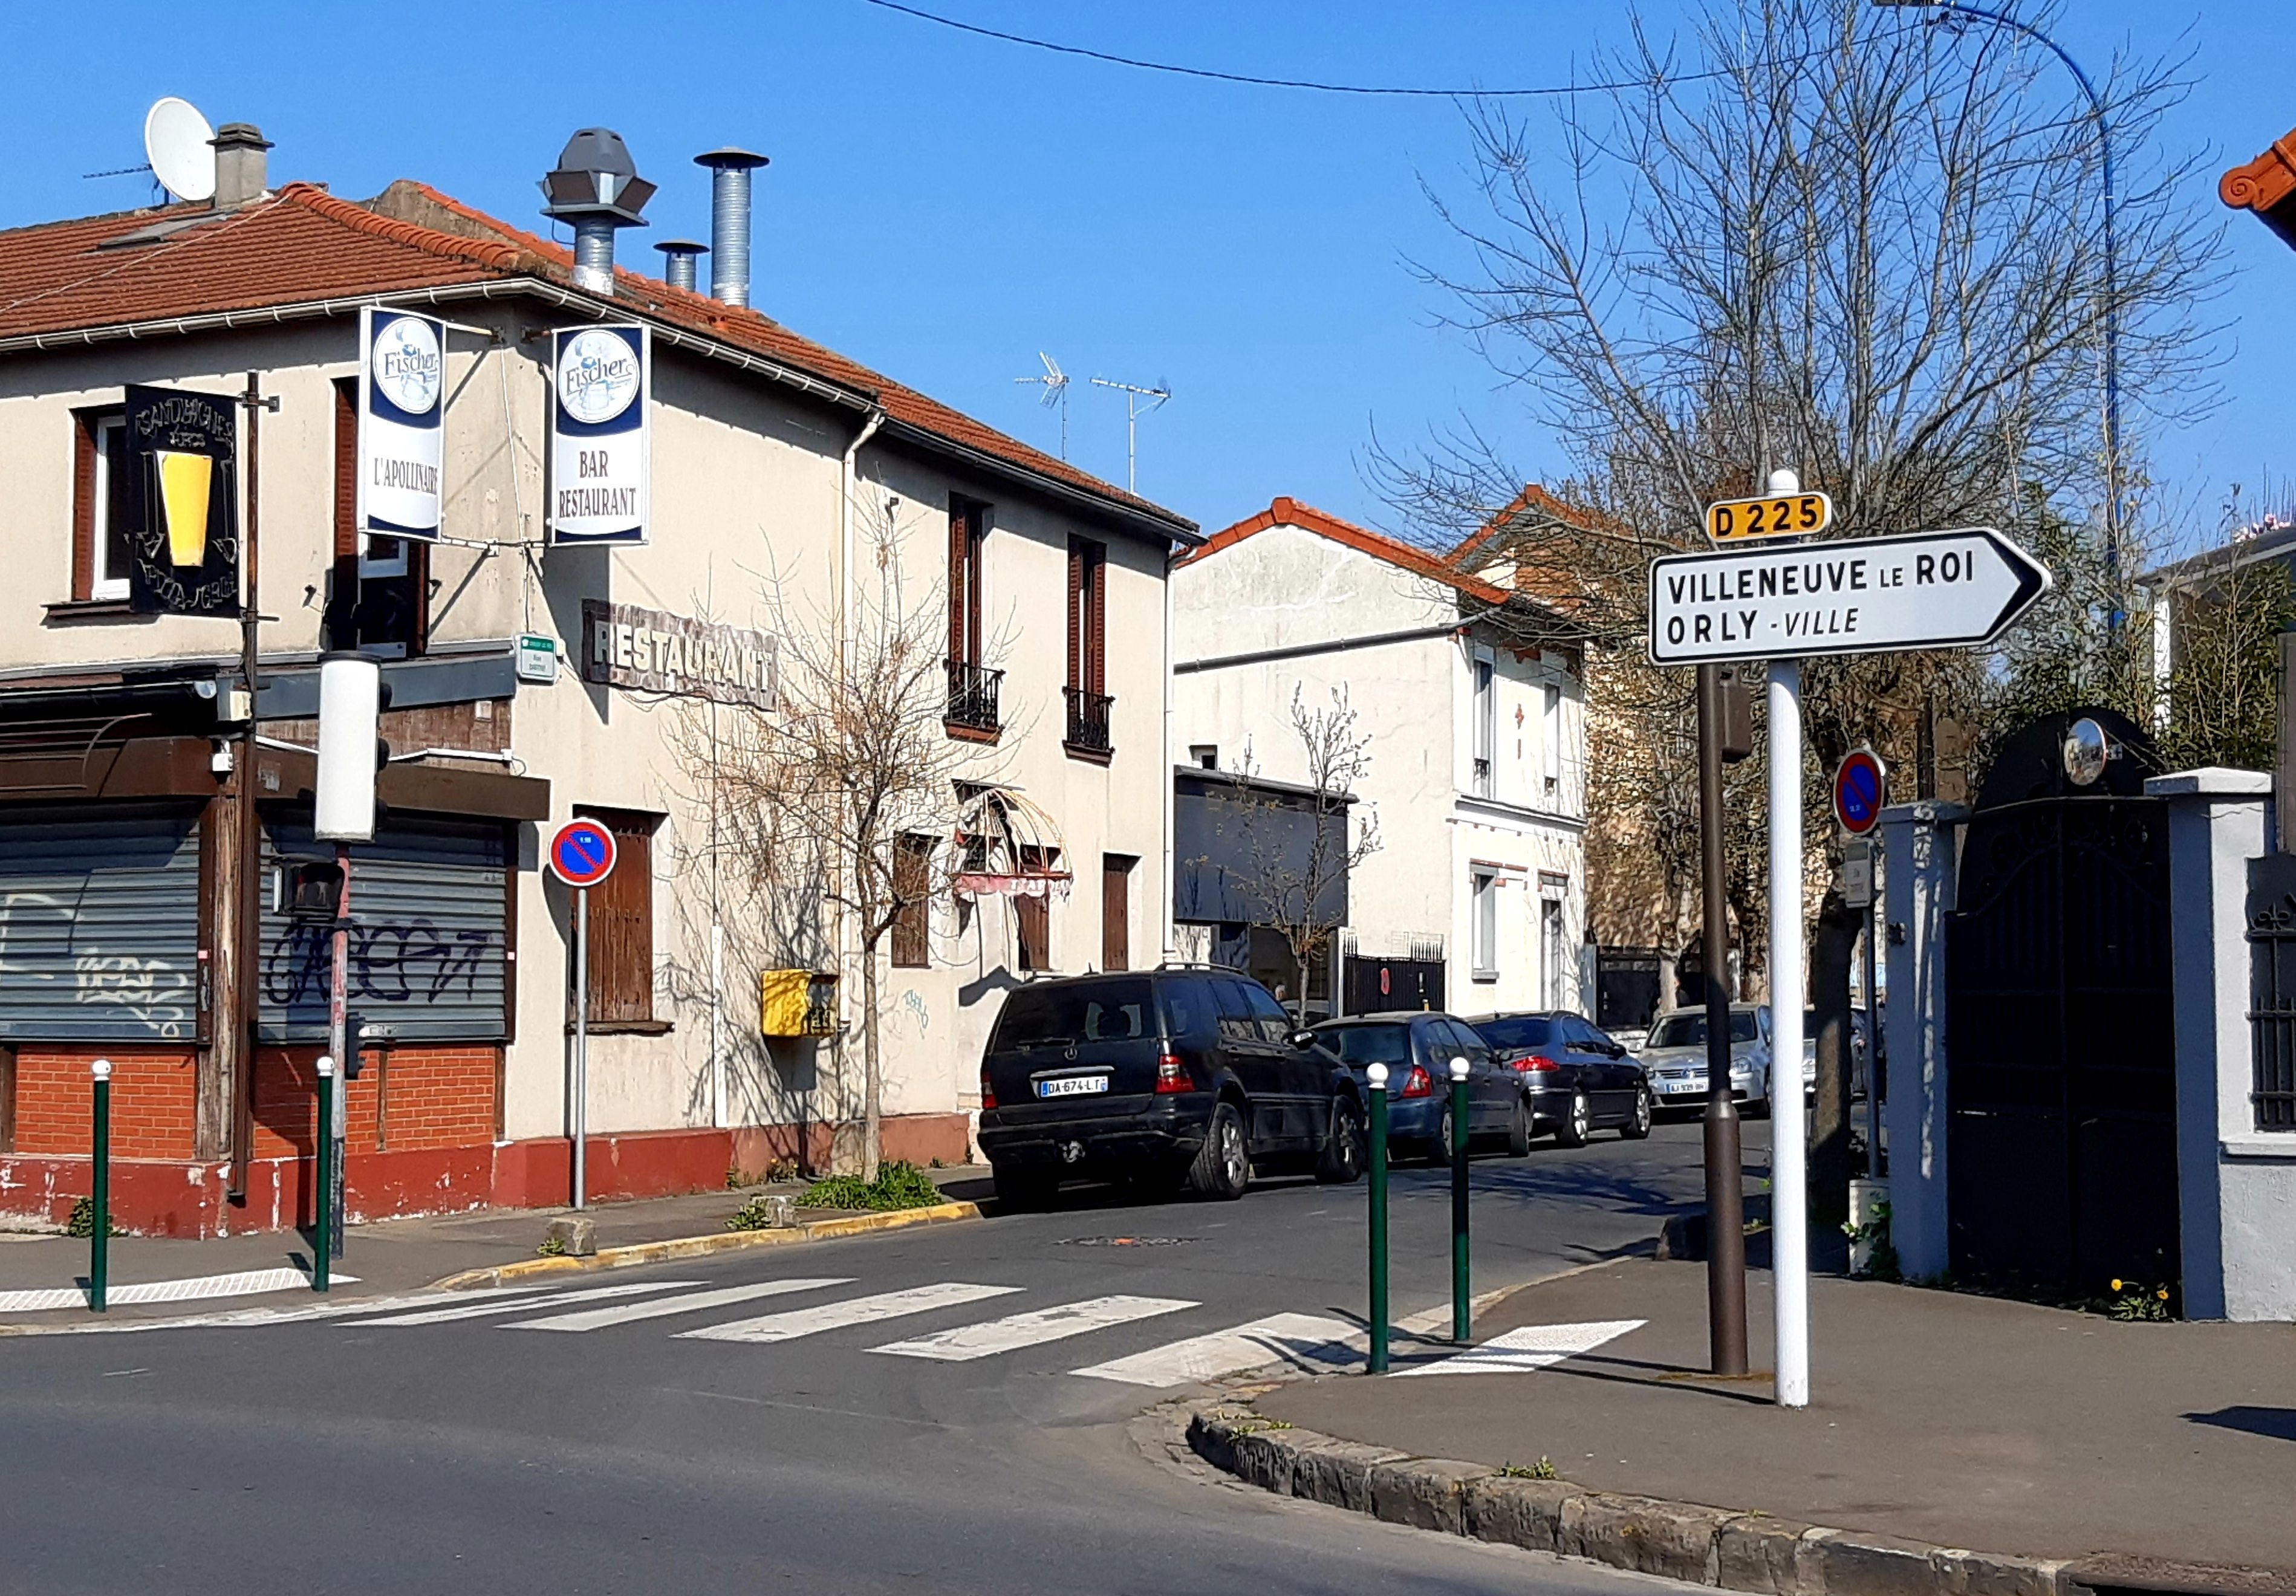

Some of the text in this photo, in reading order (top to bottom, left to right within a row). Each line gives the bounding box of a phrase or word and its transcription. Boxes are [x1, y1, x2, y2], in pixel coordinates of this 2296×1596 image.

[384, 348, 438, 378] Fischer
[565, 357, 633, 396] Fischer
[579, 450, 608, 478] BAR
[559, 487, 637, 519] RESTAURANT
[1715, 498, 1816, 536] D 225
[1668, 550, 1973, 605] VILLENEUVE LE ROI
[1667, 610, 1758, 645] ORLY
[593, 619, 773, 692] RESTAURANT
